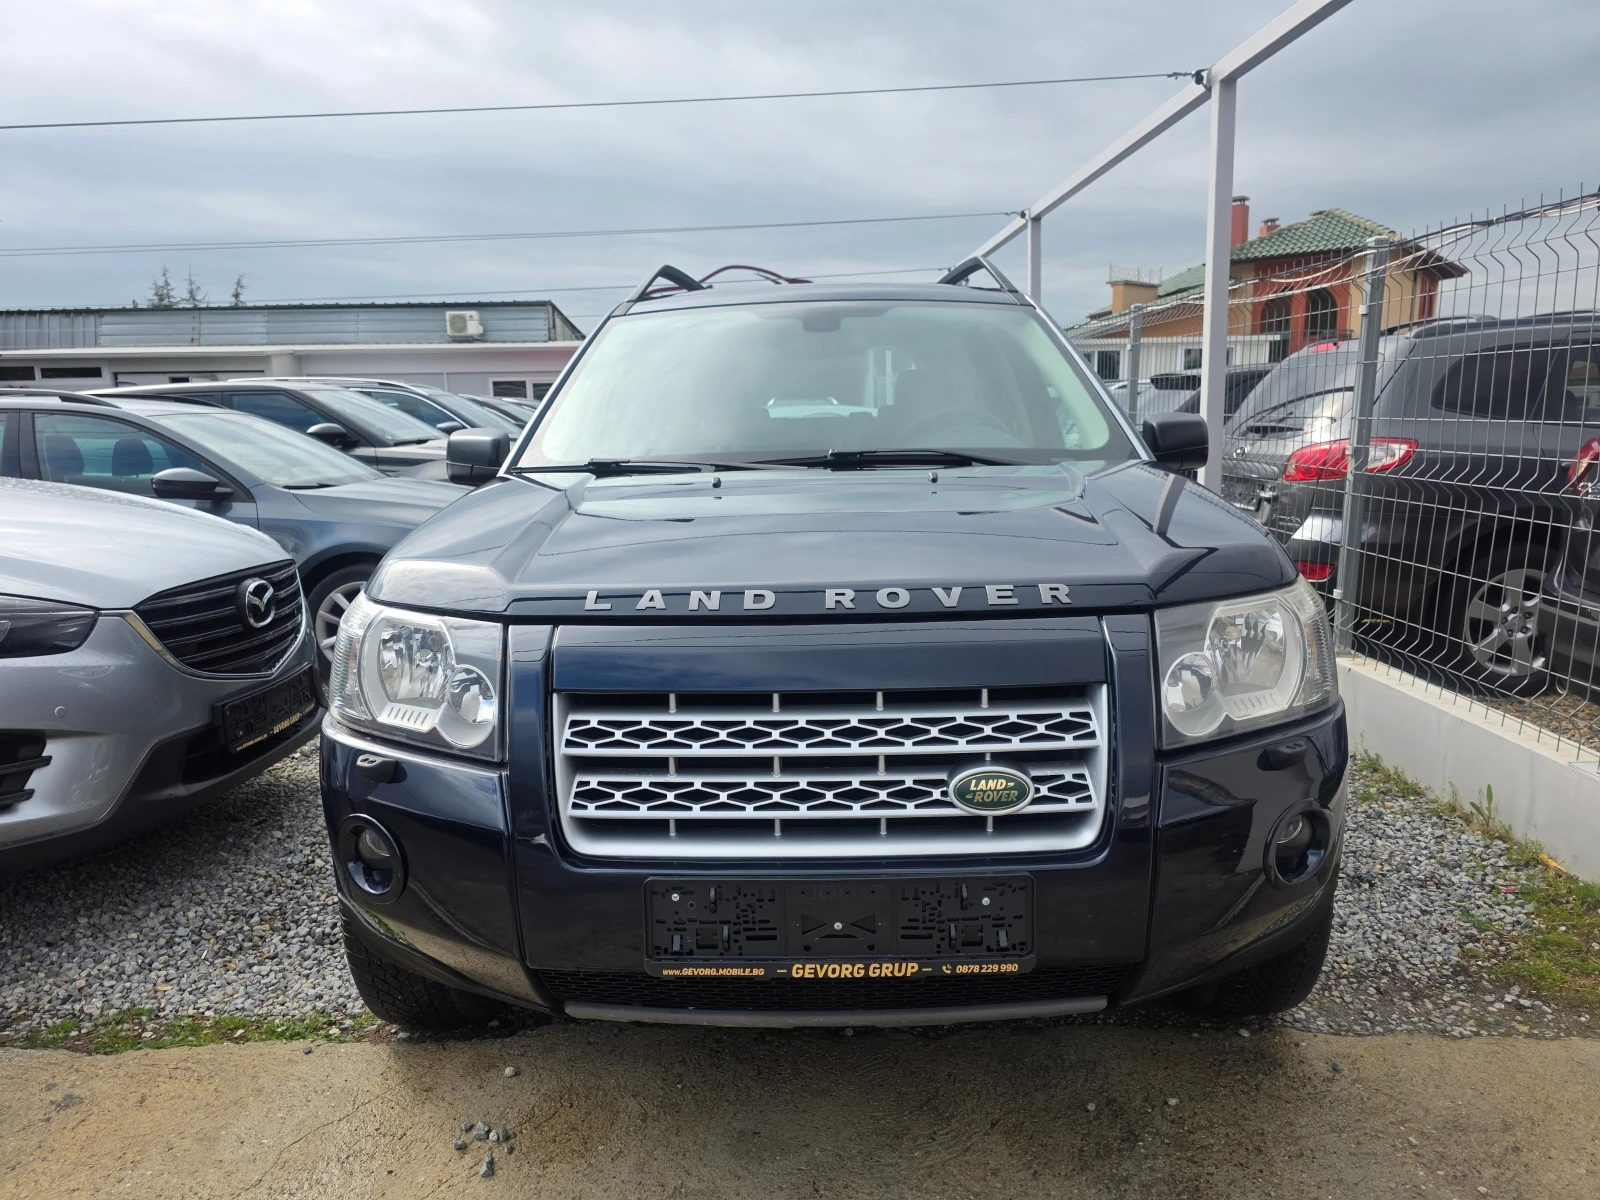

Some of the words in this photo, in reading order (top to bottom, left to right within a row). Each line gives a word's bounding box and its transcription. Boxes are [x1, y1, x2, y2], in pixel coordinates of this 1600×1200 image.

[584, 589, 776, 611] LAND
[825, 583, 1073, 610] ROVER
[970, 779, 1007, 791] LAND
[974, 791, 1019, 802] ROVER
[791, 963, 866, 978] GEVORG
[868, 962, 919, 978] GRUP
[956, 964, 980, 974] 0878
[981, 964, 999, 973] 229
[1000, 963, 1019, 972] 990
